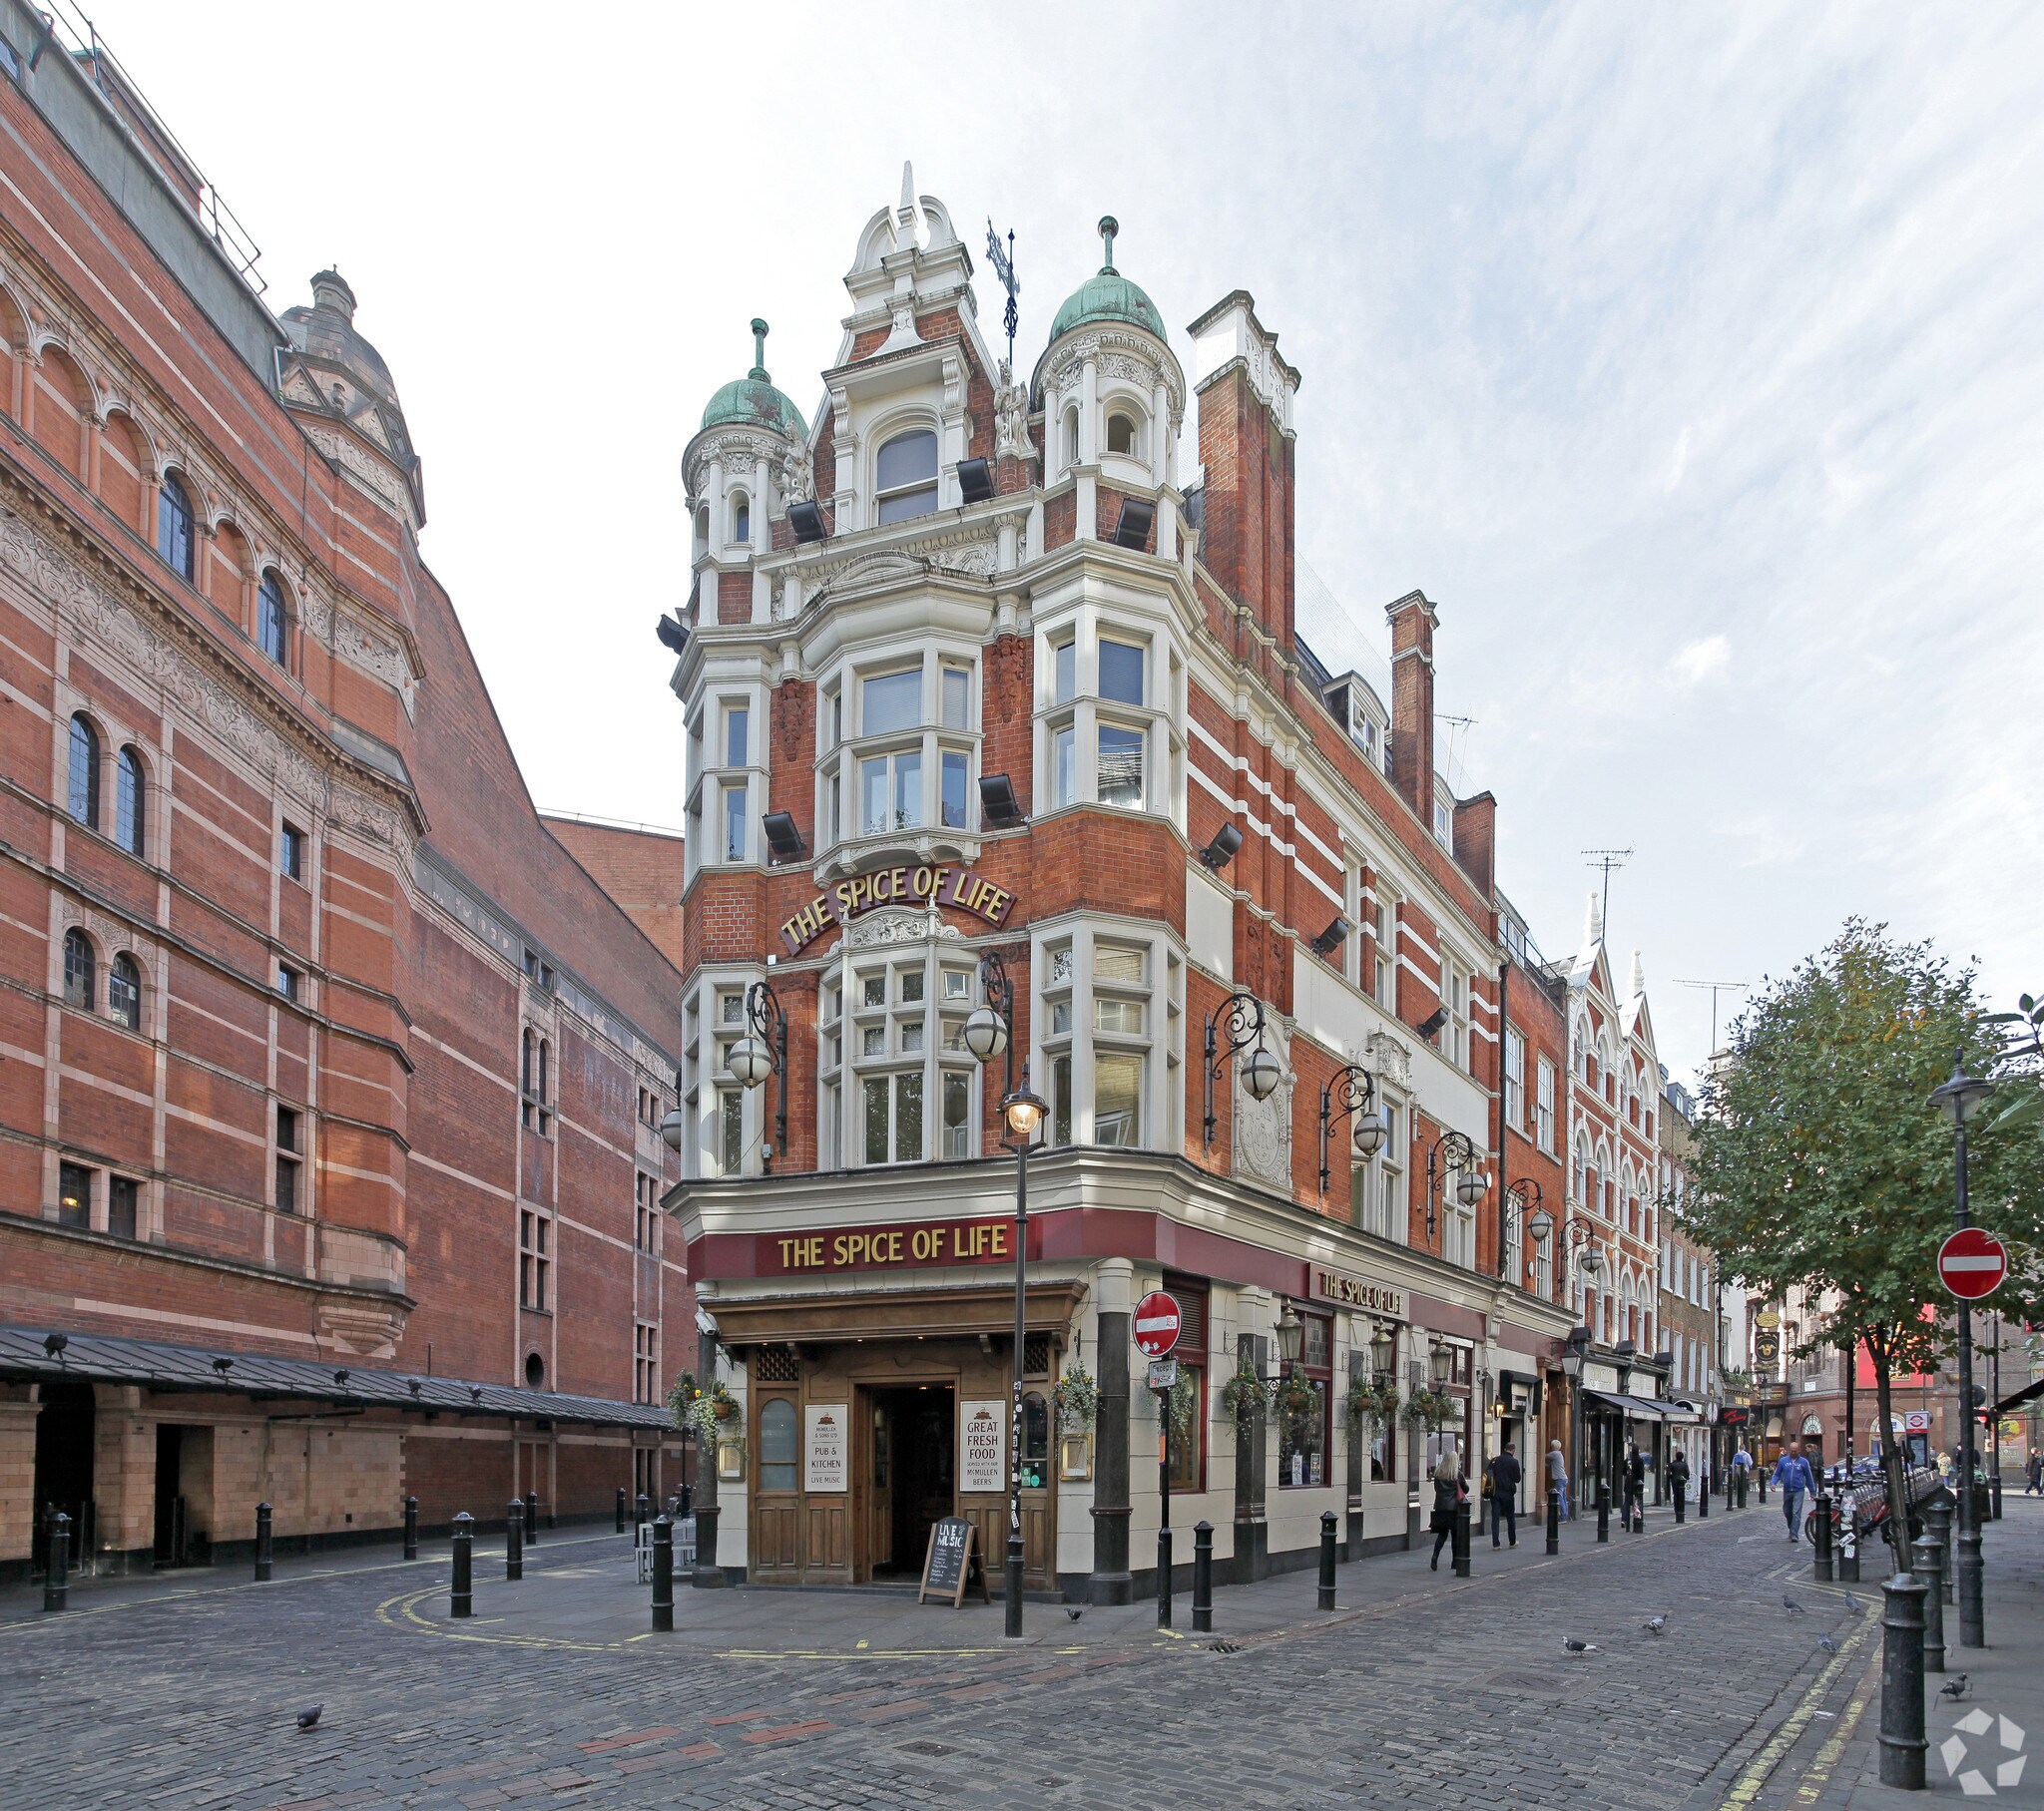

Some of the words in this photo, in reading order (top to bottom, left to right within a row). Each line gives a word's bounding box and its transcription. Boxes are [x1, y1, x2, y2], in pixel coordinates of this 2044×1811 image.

[780, 894, 833, 945] THE
[835, 867, 907, 913] SPICE
[912, 866, 949, 896] OF
[952, 872, 1011, 922] LIFE
[777, 1237, 825, 1268] THE
[832, 1232, 904, 1266] SPICE
[911, 1228, 946, 1260] OF
[954, 1224, 1008, 1257] LIFE
[1323, 1272, 1343, 1299] THE
[1345, 1278, 1372, 1306] SPICE
[1373, 1287, 1386, 1310] OF
[1386, 1290, 1404, 1314] LIFE
[967, 1421, 998, 1433] GREAT
[967, 1435, 998, 1446] FRESH
[814, 1447, 829, 1456] PUB
[831, 1447, 837, 1456] &
[969, 1448, 996, 1459] FOOD
[811, 1460, 841, 1469] KITCHEN
[939, 1524, 957, 1537] LIVE
[937, 1536, 964, 1548] MUSIC
